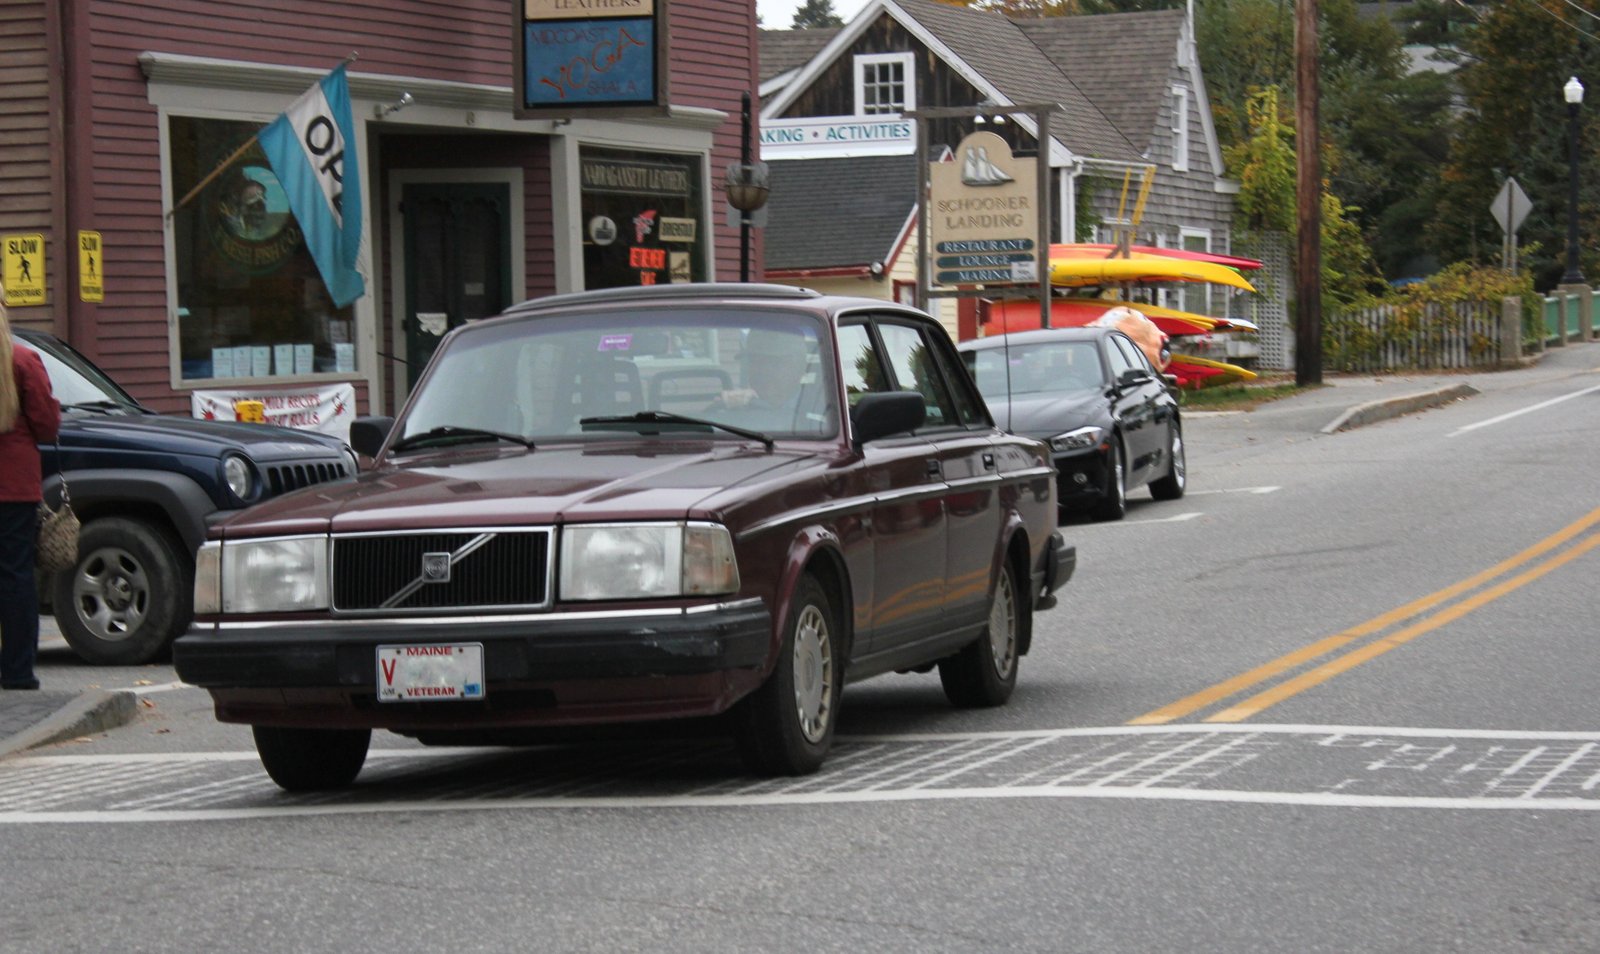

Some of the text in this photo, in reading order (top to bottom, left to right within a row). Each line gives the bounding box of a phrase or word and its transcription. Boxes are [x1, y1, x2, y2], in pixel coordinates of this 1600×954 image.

[540, 27, 646, 98] YOGA
[825, 123, 911, 141] ACTIVITIES
[937, 196, 1030, 213] SCHOONER
[945, 213, 1024, 230] LANDING
[9, 239, 38, 254] SLOW
[944, 240, 1025, 253] RESTAURANT
[960, 255, 1010, 267] LOUNGE
[959, 269, 1010, 281] MARINA
[406, 645, 453, 656] MAINE
[381, 659, 396, 686] V
[406, 686, 455, 697] VETERAN
